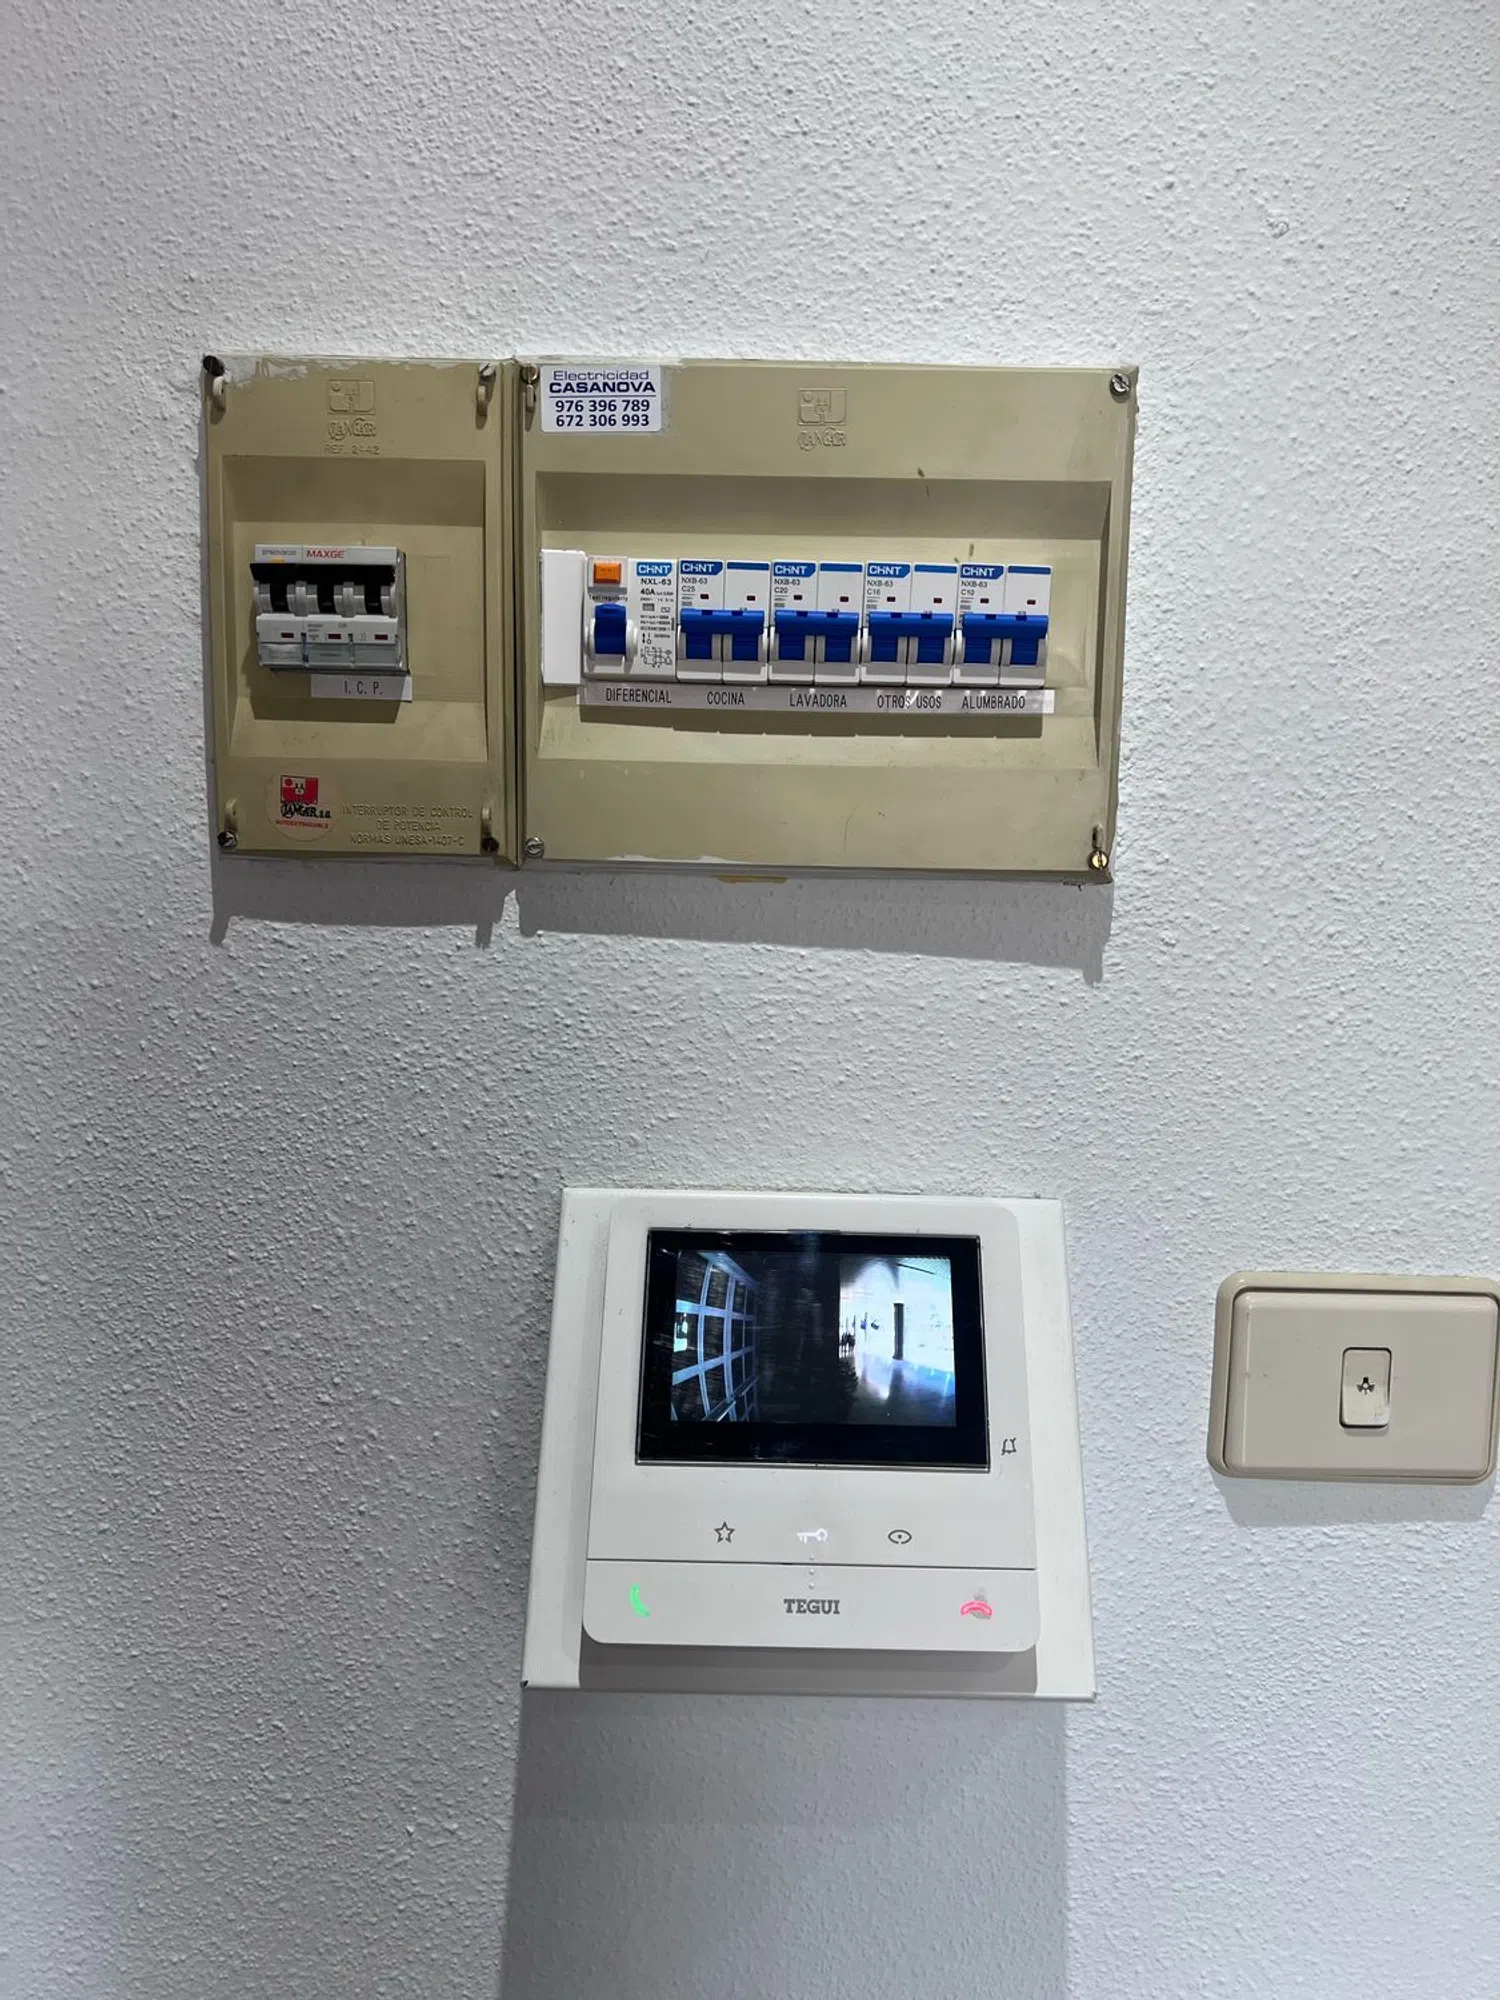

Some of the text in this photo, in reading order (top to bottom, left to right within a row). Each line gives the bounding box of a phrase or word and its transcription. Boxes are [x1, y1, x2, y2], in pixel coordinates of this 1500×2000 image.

[553, 370, 649, 380] Electricidad
[549, 381, 656, 393] CASANOVA
[555, 399, 650, 412] 976 396 789
[556, 414, 650, 427] 672 306 993
[306, 550, 345, 558] MAXGE
[640, 578, 672, 586] NXL-63
[606, 687, 672, 704] DIFERENCIAL
[707, 691, 745, 705] COCINA
[789, 693, 847, 708] LAVADORA
[961, 695, 1026, 709] ALUMBRADO
[877, 696, 942, 709] OTROS USOS
[342, 802, 473, 818] INTERRUPTOR DE CONTROL
[376, 820, 440, 831] DE POTENCIA
[783, 1598, 840, 1614] TEGUI
